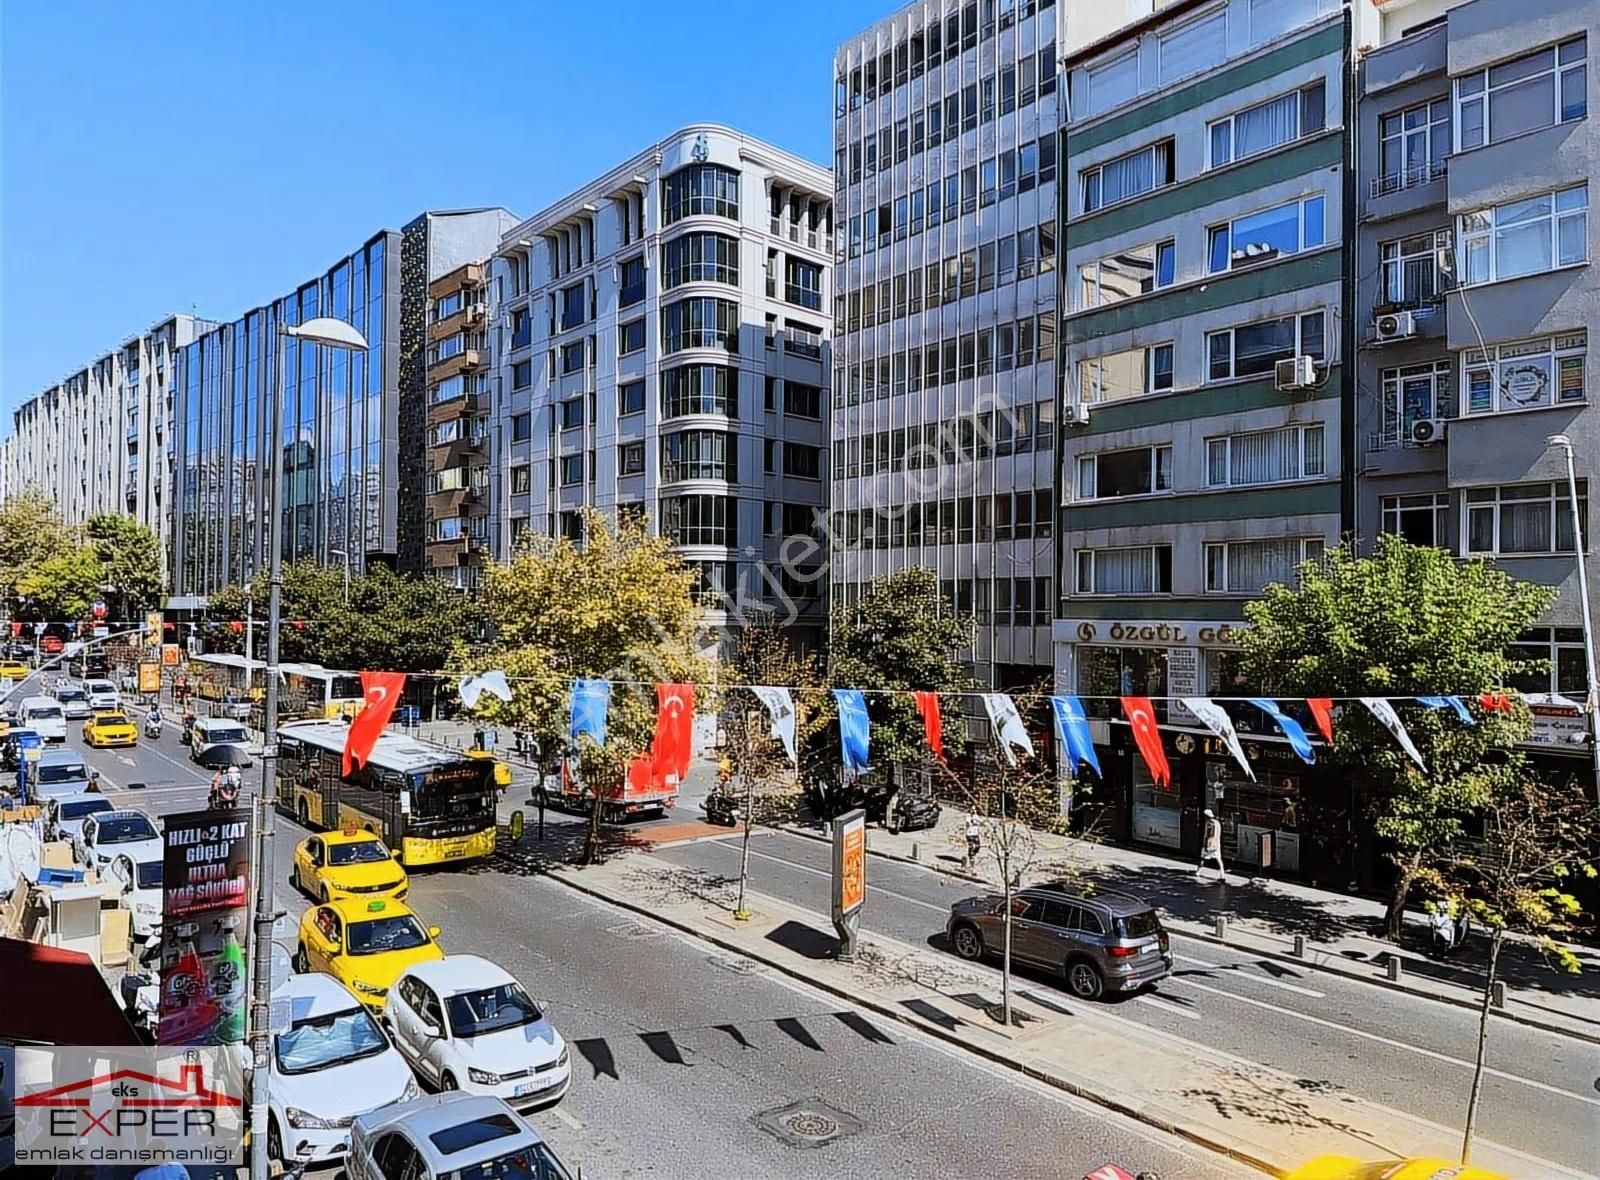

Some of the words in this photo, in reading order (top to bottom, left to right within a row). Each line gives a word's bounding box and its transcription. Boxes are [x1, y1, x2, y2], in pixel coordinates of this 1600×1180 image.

[1109, 622, 1187, 642] ÖZGÜL
[168, 828, 201, 846] HIZLI
[209, 826, 218, 840] 2
[221, 822, 248, 839] KAT
[188, 863, 226, 882] ULTRA
